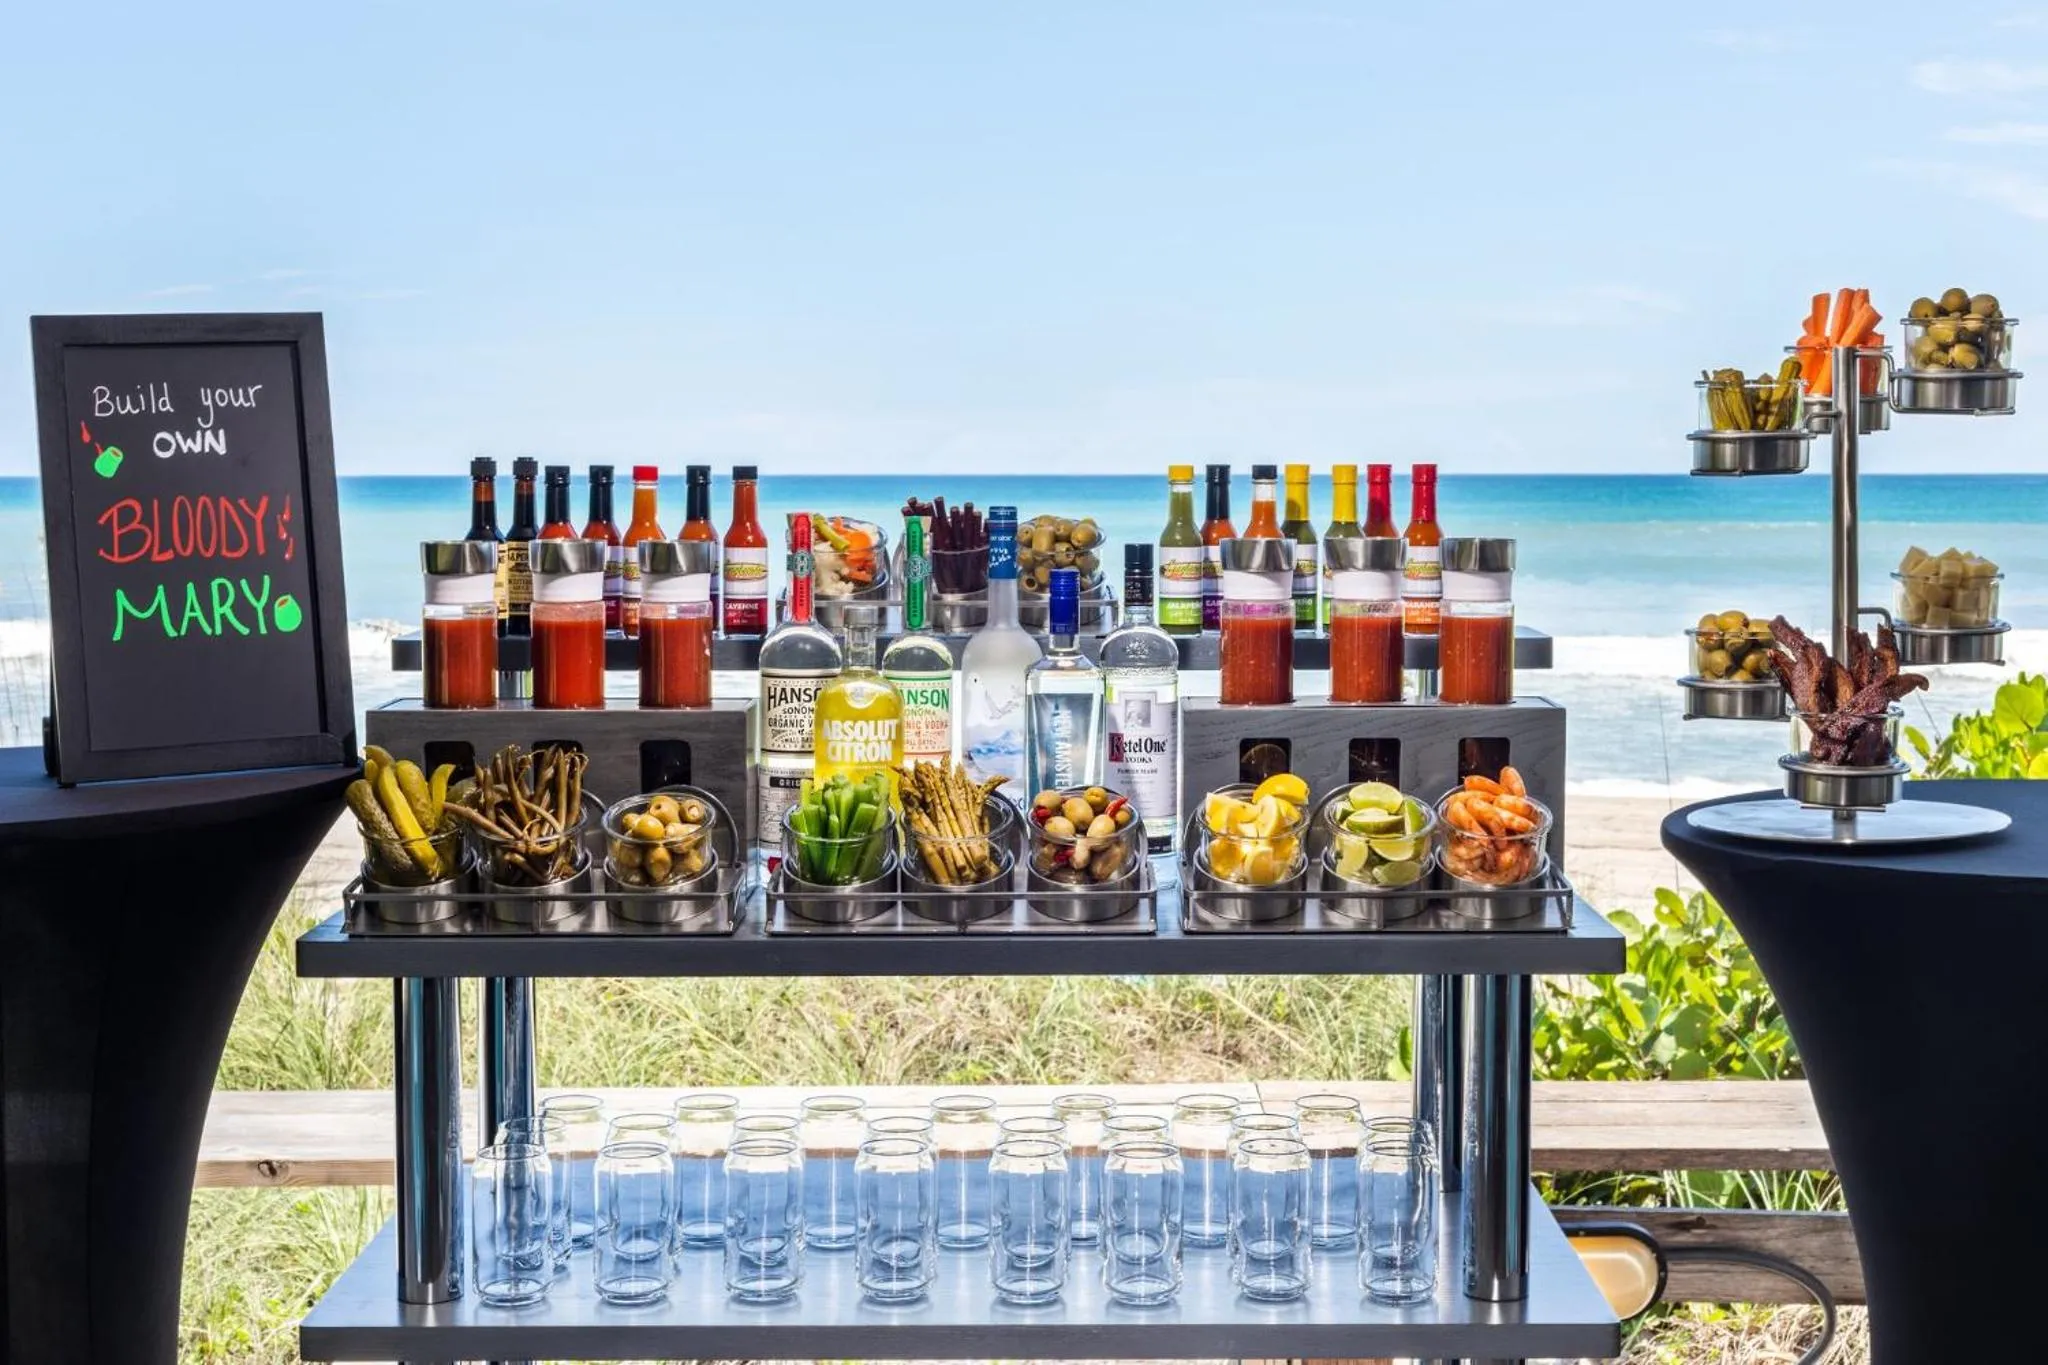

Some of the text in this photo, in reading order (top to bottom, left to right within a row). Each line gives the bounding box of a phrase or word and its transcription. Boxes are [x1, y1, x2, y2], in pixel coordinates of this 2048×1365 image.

[93, 383, 263, 428] Build your
[152, 429, 228, 459] OWN
[97, 495, 269, 563] BLOODY
[111, 575, 270, 642] MARY
[768, 718, 805, 728] ORGANIC
[823, 719, 897, 740] ABSOLUT
[1054, 709, 1073, 738] NEW
[827, 740, 892, 762] CITRON
[1109, 735, 1167, 757] Ketel One
